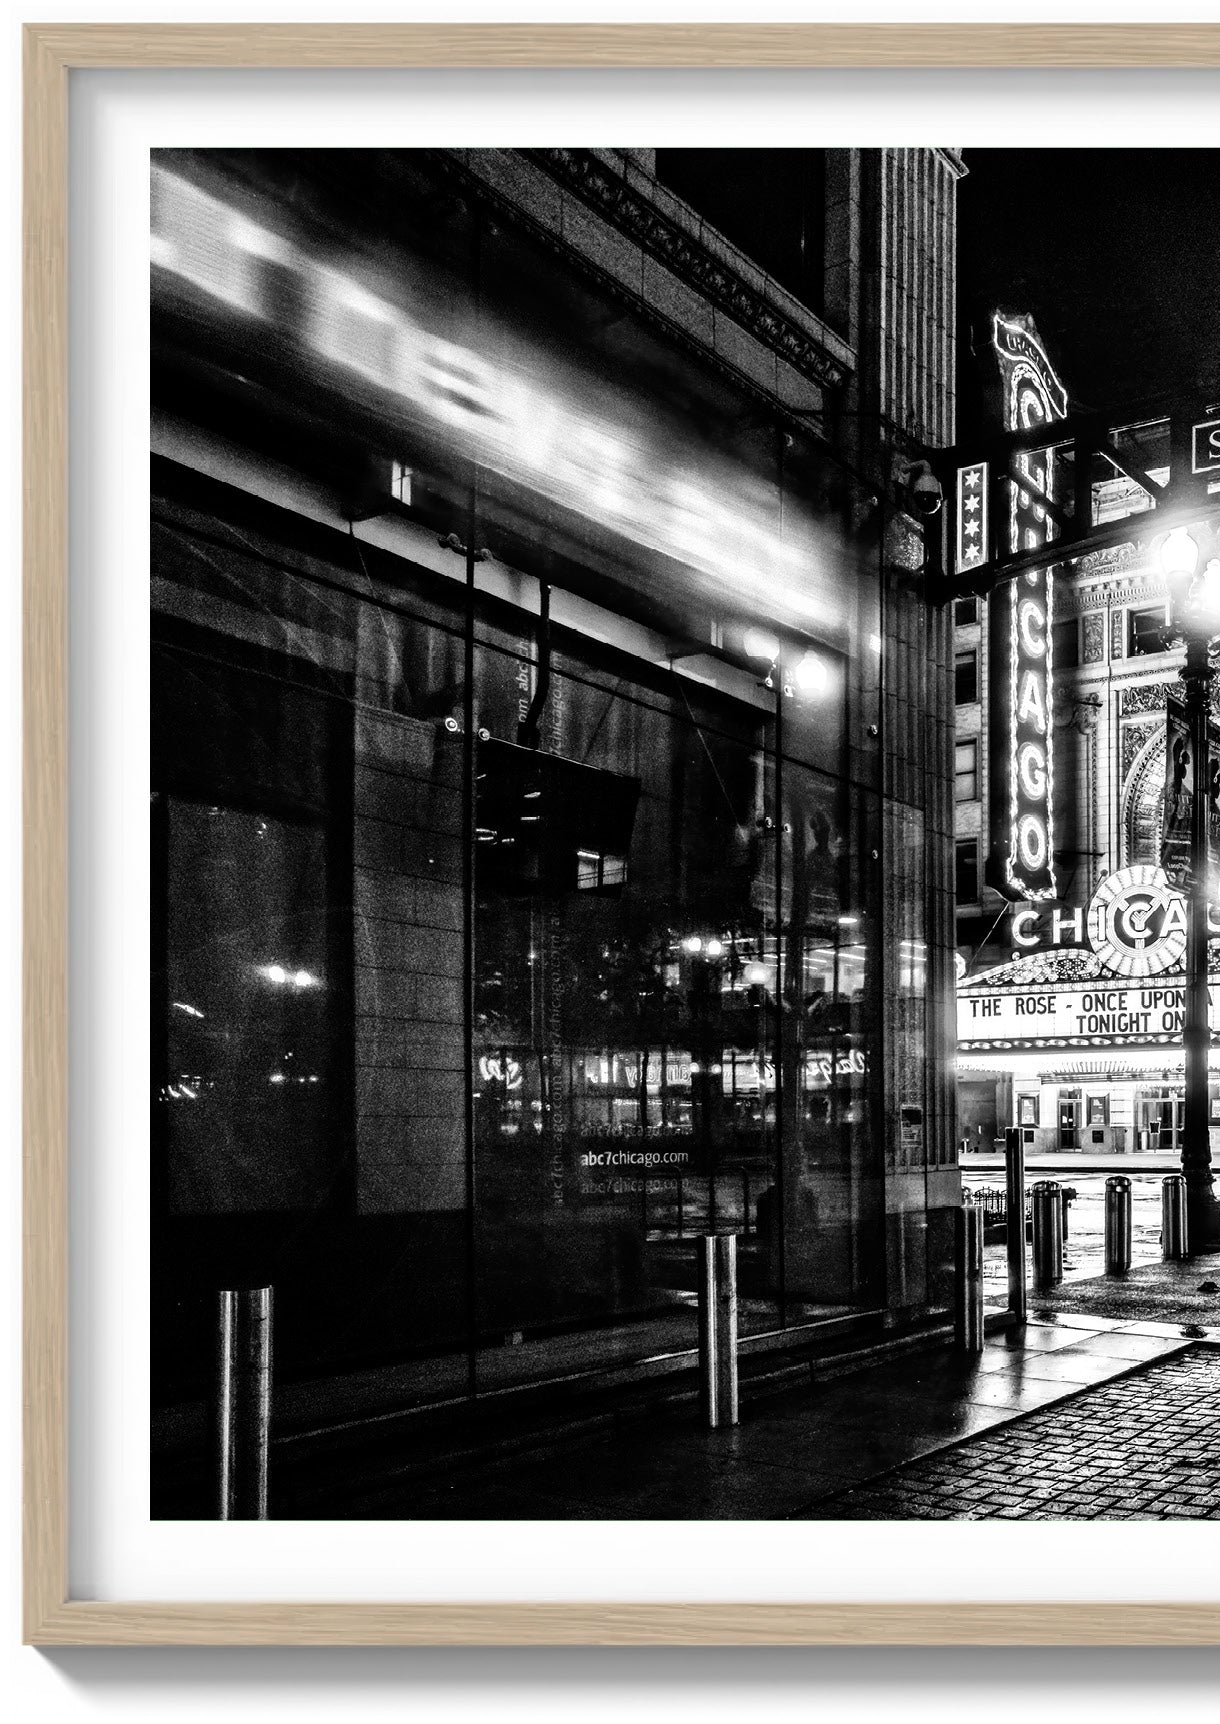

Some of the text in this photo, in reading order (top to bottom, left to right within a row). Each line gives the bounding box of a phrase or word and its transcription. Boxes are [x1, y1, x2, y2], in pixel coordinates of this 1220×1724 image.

[970, 998, 1002, 1018] THE
[1015, 995, 1057, 1015] ROSE
[1081, 991, 1128, 1013] ONCE
[1140, 989, 1186, 1010] UPON
[1076, 1012, 1152, 1034] TONIGHT
[580, 1150, 689, 1168] abc7chicago.com
